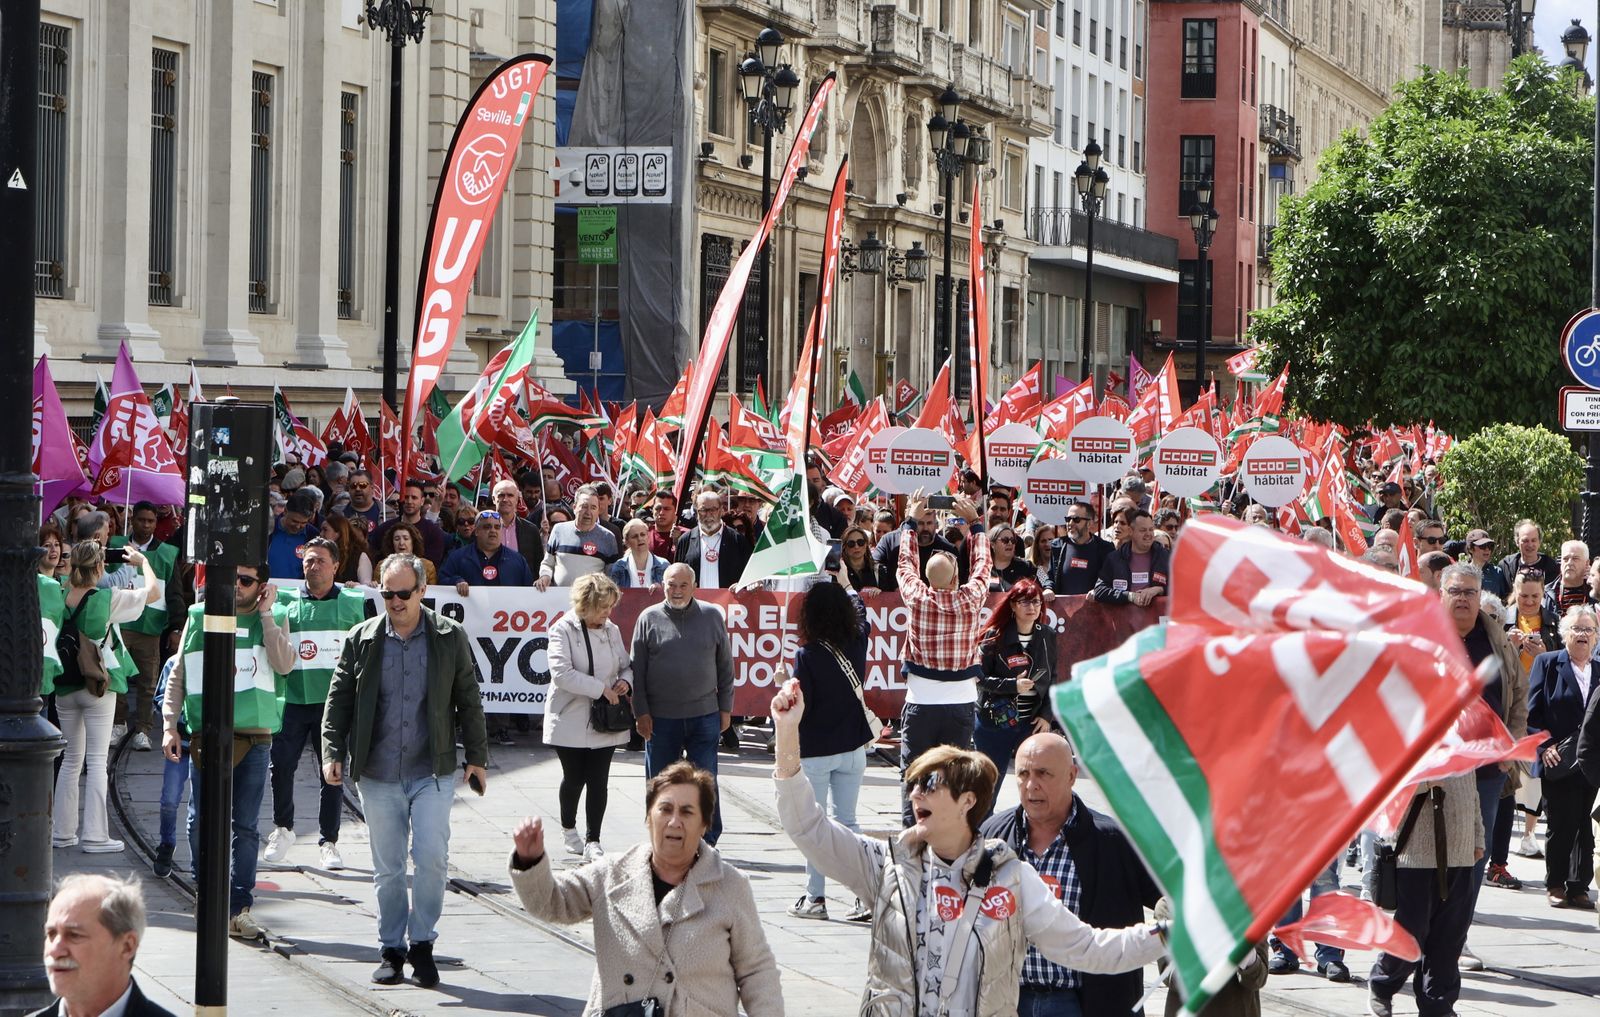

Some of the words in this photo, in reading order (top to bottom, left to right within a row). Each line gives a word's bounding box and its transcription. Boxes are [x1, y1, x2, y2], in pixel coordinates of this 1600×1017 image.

[492, 63, 535, 99] UGT
[477, 107, 512, 125] Sevilla
[991, 445, 1025, 455] CCOO
[1074, 440, 1112, 450] CCOO
[893, 452, 931, 462] CCOO
[994, 457, 1030, 468] hábita
[1078, 453, 1123, 464] hábitat
[1162, 453, 1199, 462] CCOO
[897, 464, 941, 477] hábitat
[1165, 465, 1208, 477] hábitat
[1249, 462, 1284, 471] CCOO
[1254, 474, 1294, 486] hábitat
[1030, 481, 1067, 492] CCOO
[759, 604, 798, 630] EL
[300, 643, 315, 651] UGT
[480, 691, 547, 703] #1MAYO20
[981, 891, 1010, 911] UGT
